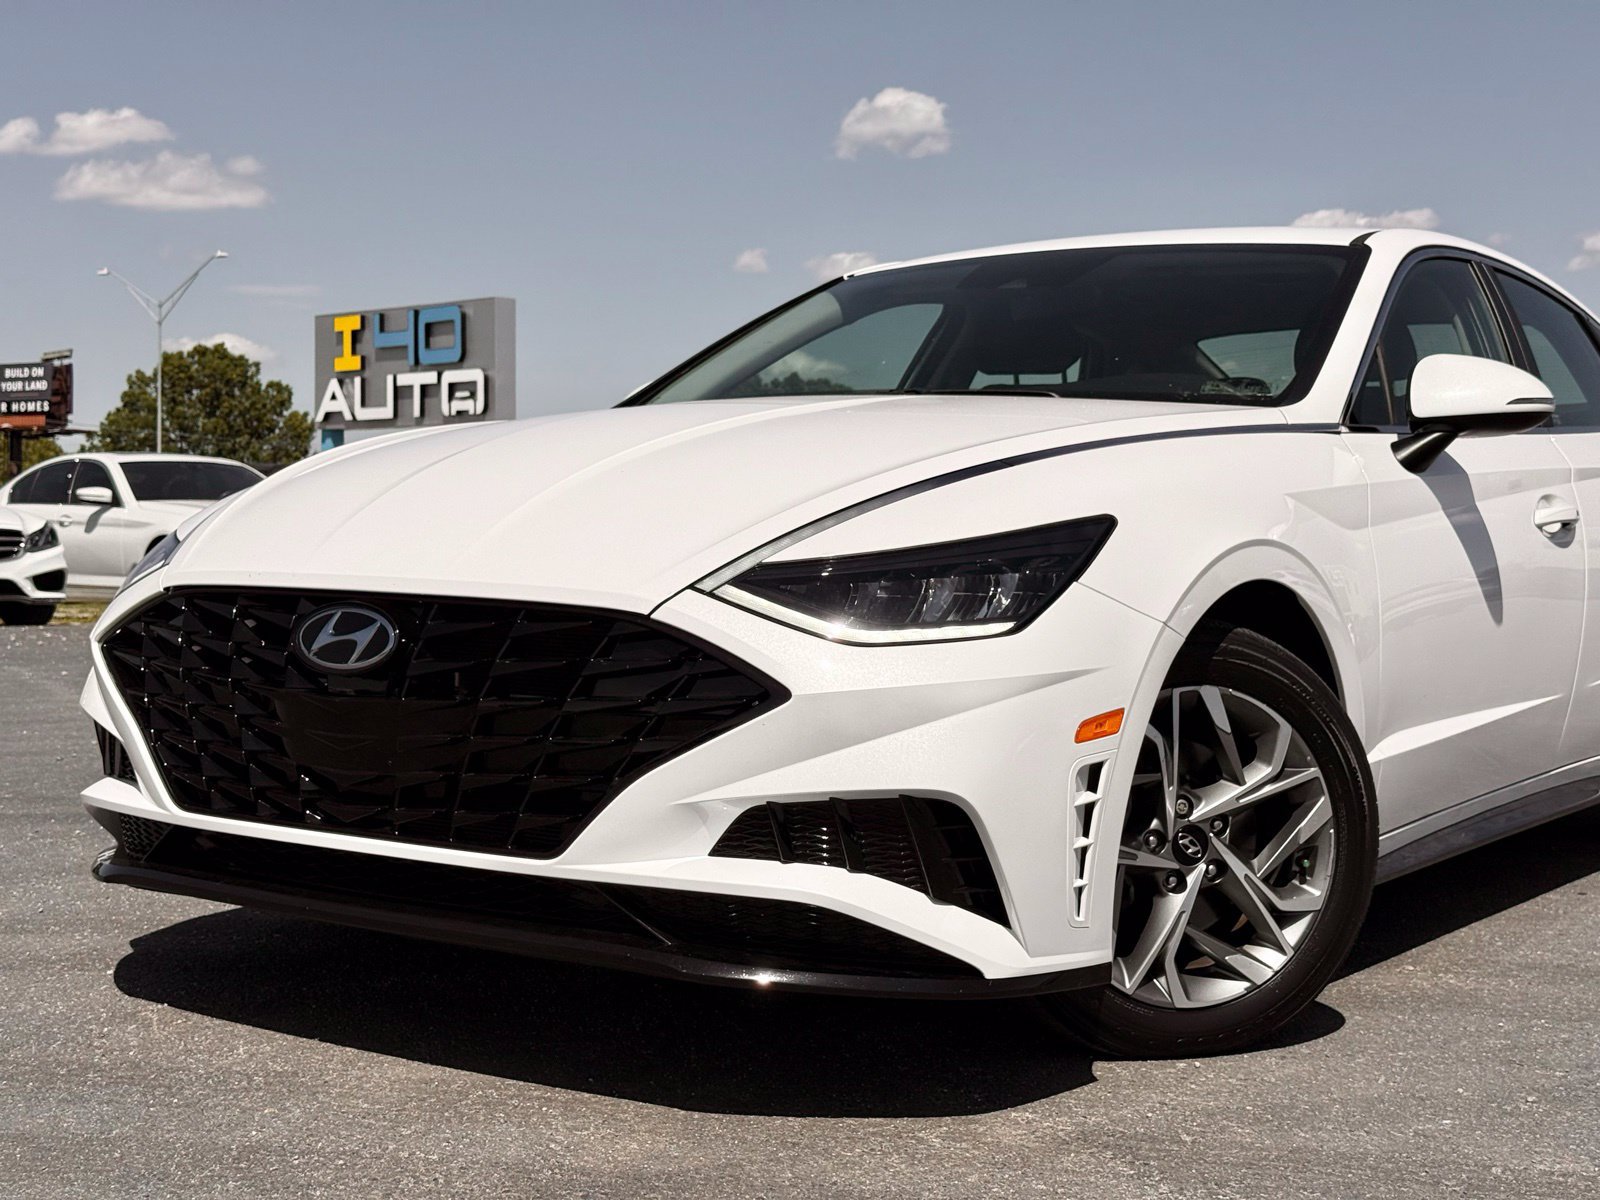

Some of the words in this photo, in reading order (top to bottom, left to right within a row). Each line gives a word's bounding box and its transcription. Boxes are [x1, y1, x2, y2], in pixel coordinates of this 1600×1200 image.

[333, 314, 361, 372] I
[373, 305, 462, 366] 40
[4, 367, 30, 379] BUILD
[31, 367, 45, 378] ON
[1, 381, 24, 392] YOUR
[25, 380, 48, 391] LAND
[315, 368, 485, 422] AUTO
[11, 401, 50, 412] HOMES
